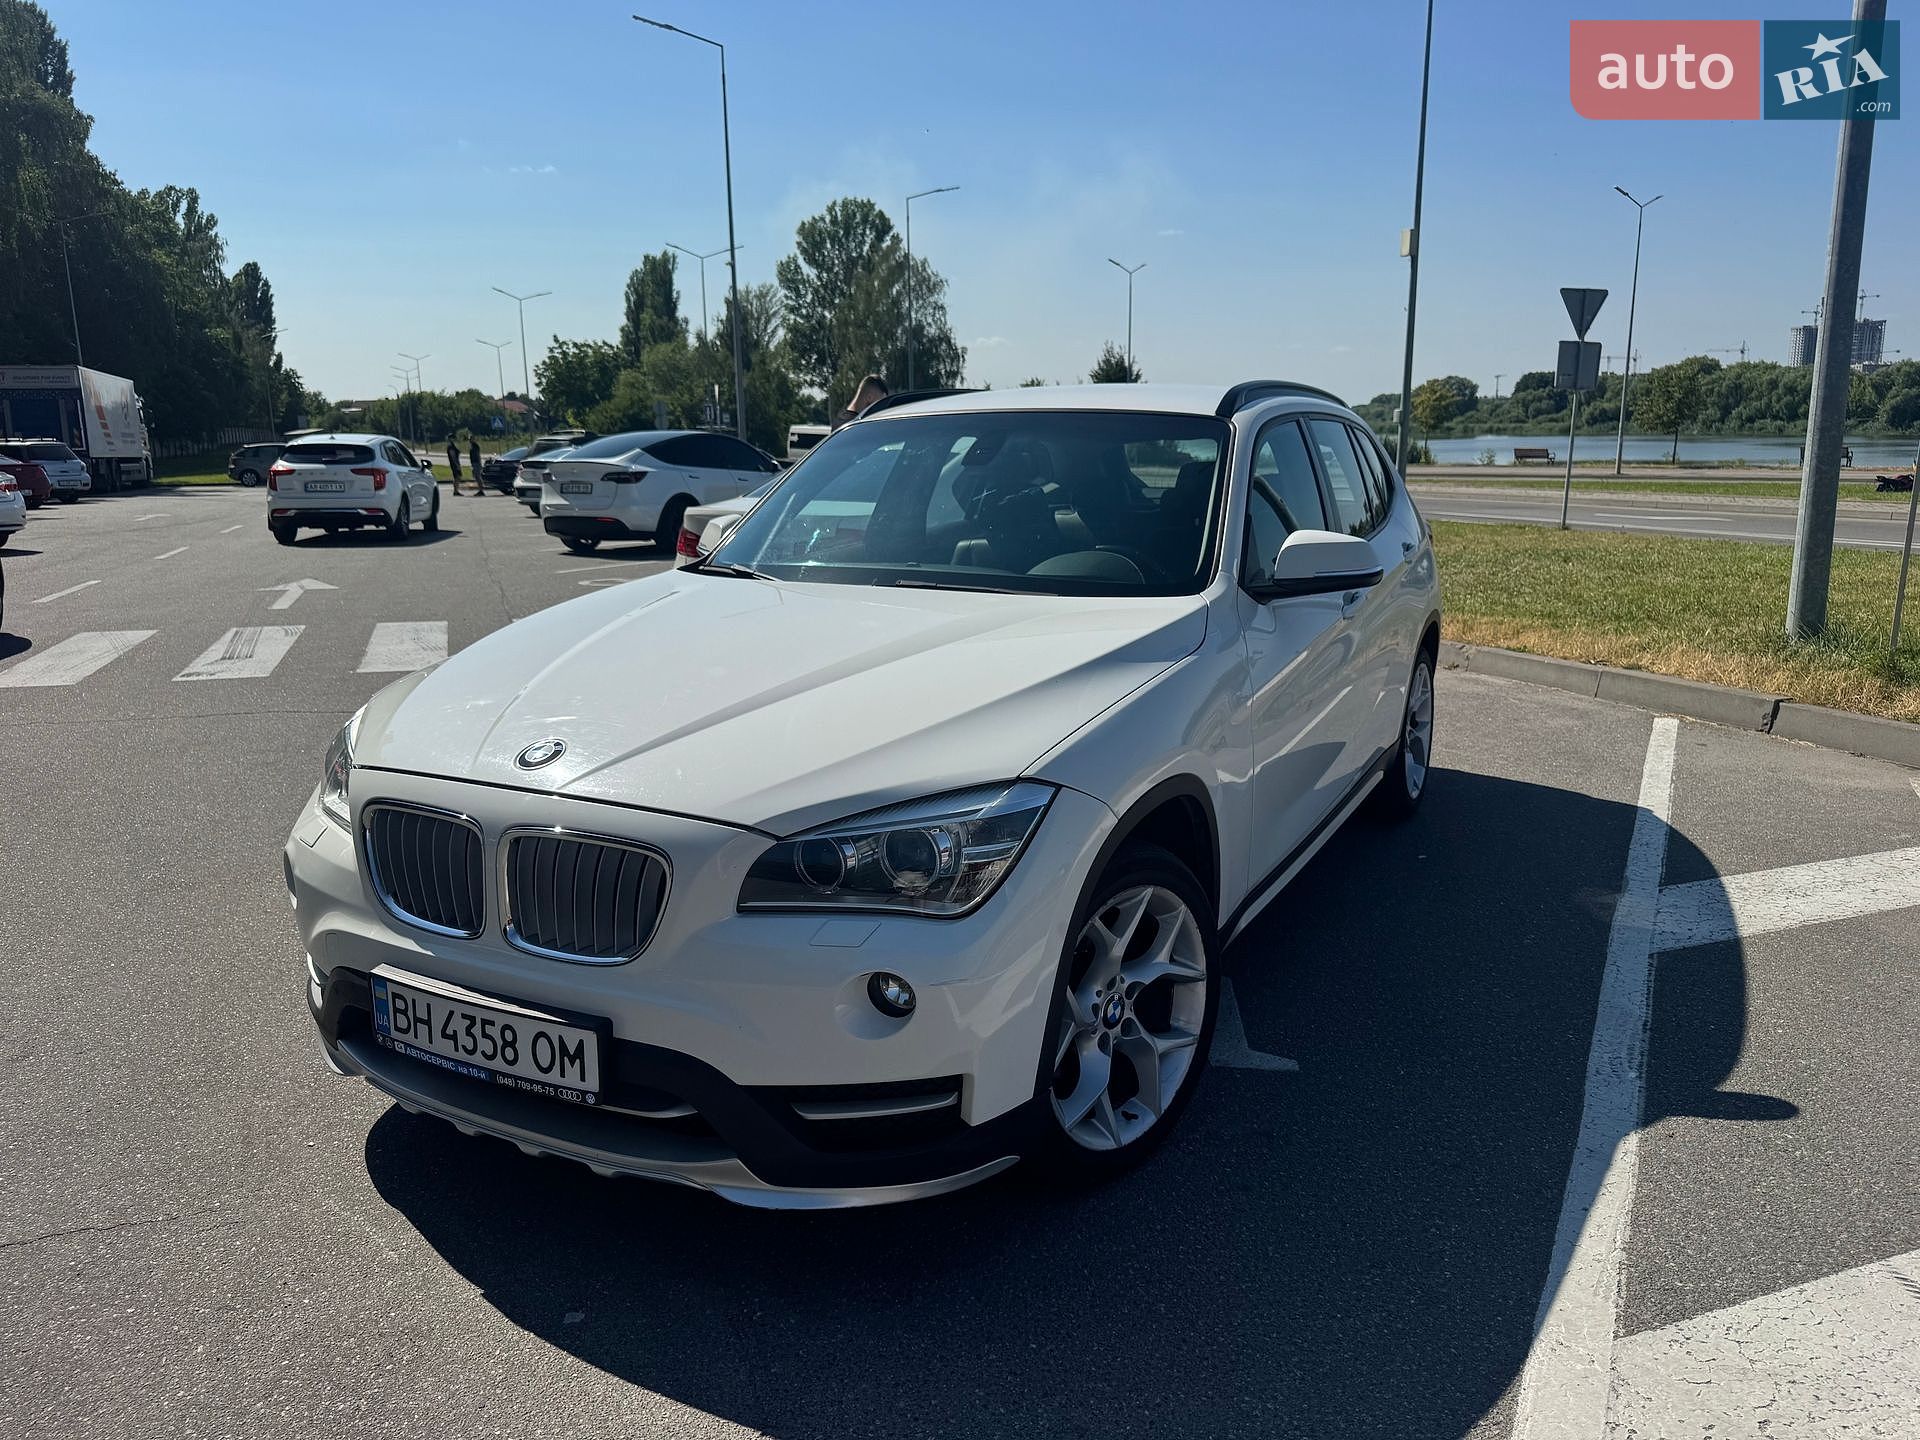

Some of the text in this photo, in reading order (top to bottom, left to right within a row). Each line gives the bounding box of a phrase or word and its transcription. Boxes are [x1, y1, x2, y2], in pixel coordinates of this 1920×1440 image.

[377, 1013, 390, 1027] UA
[391, 991, 586, 1083] BH 4358 OM
[405, 1046, 456, 1072] АВТОСЕРВІС
